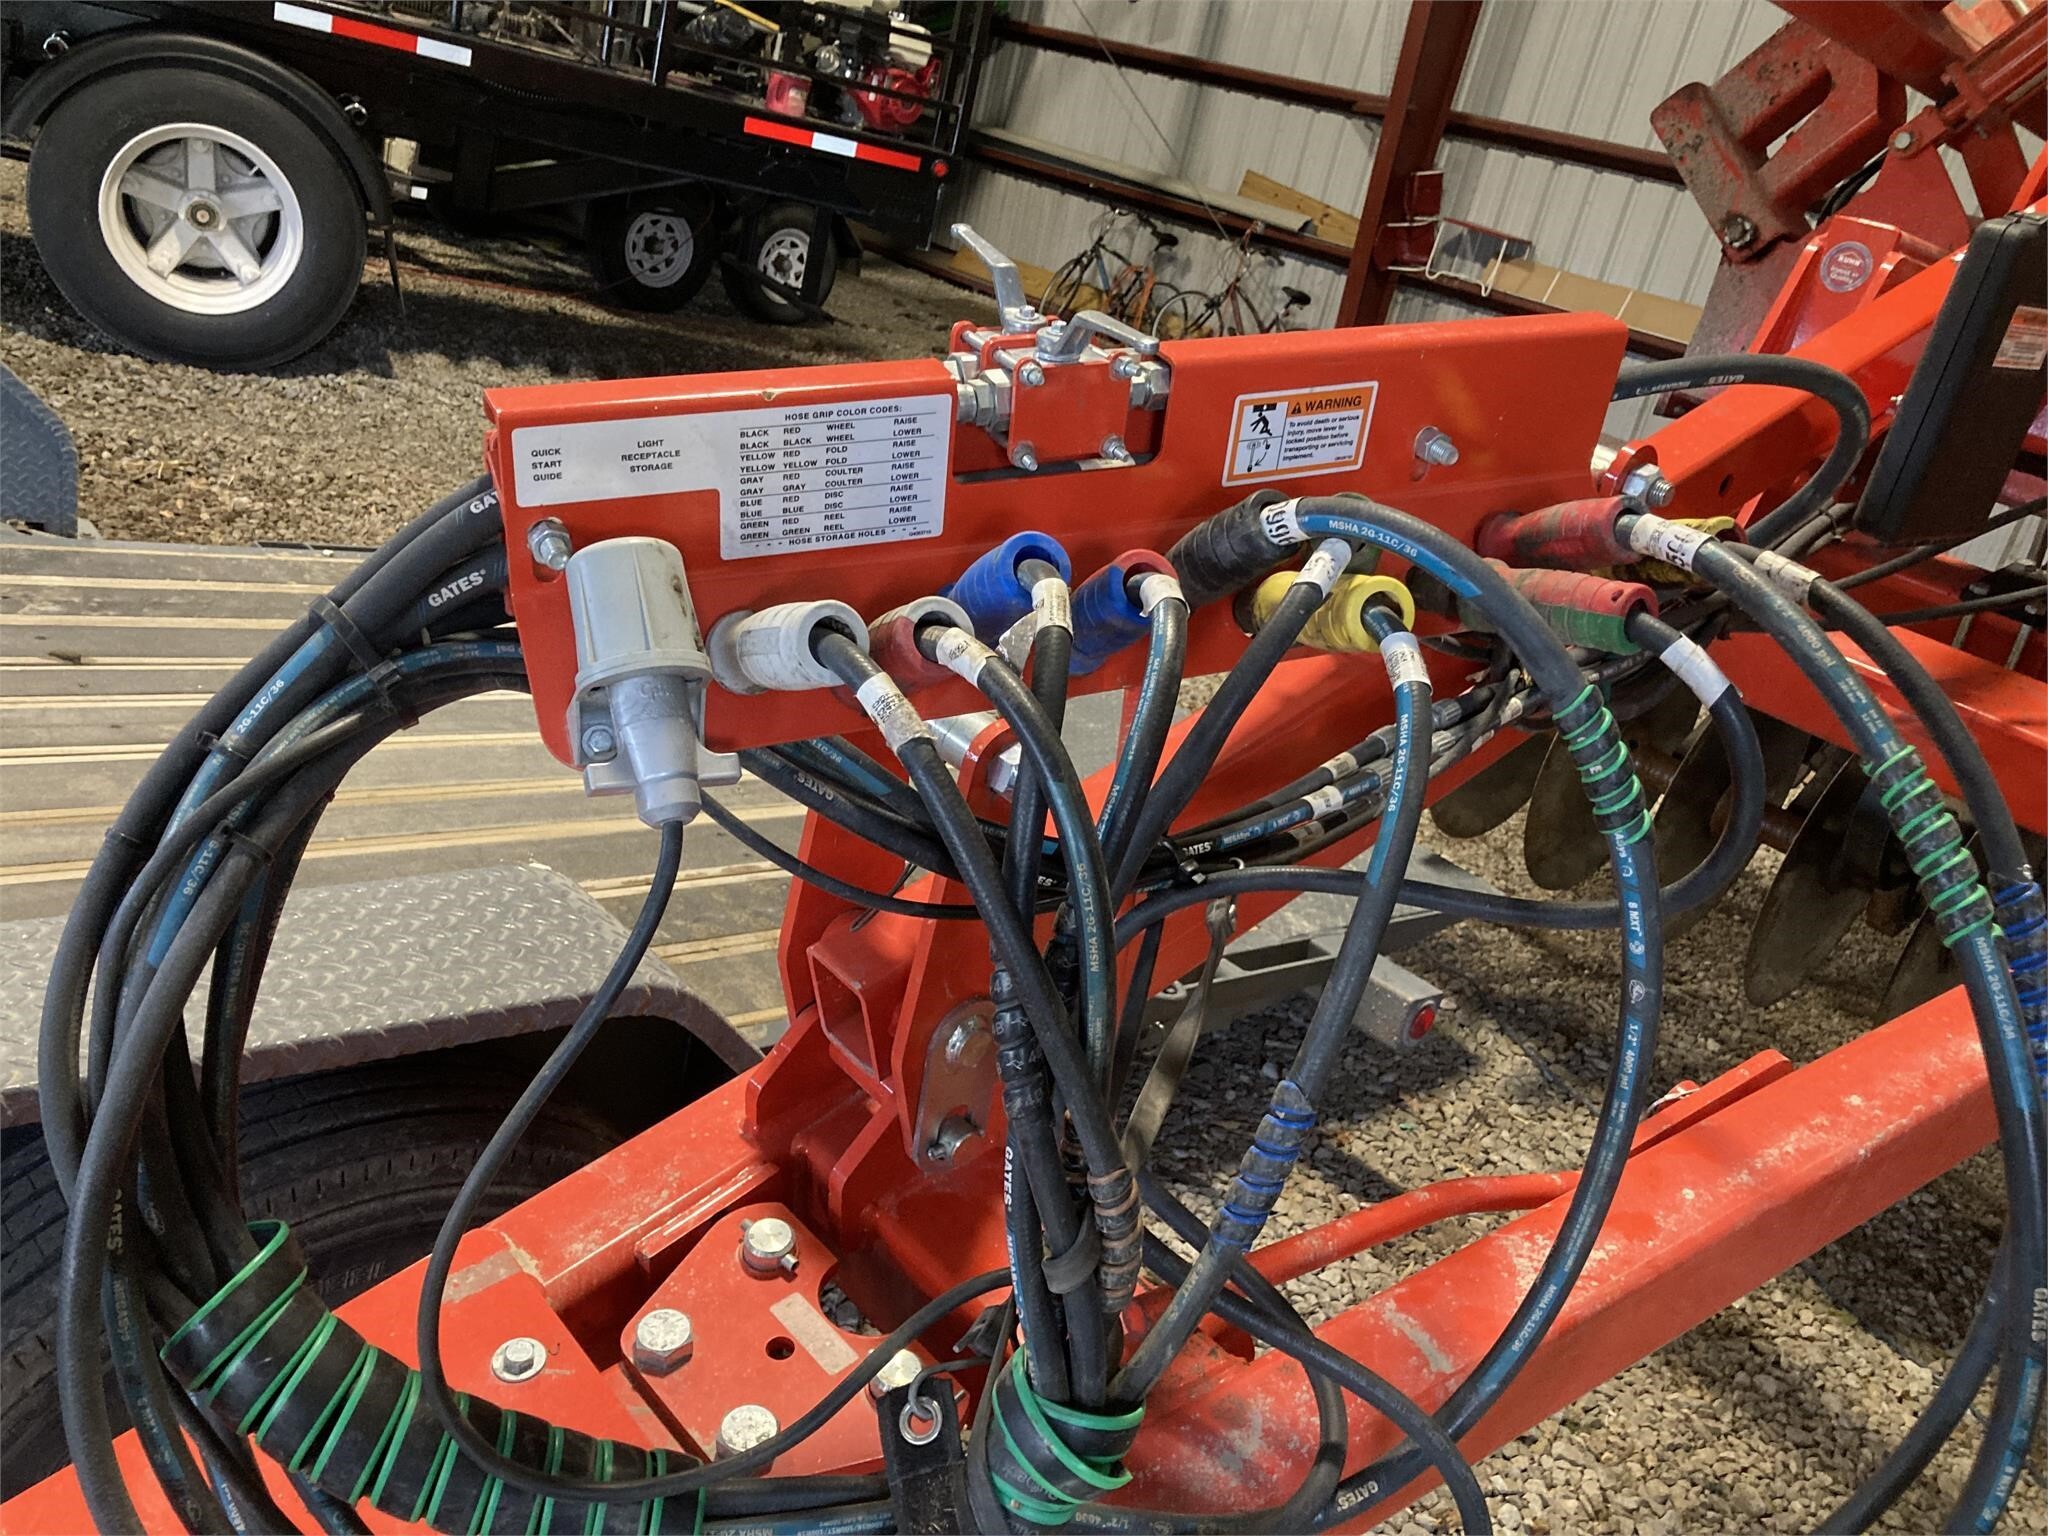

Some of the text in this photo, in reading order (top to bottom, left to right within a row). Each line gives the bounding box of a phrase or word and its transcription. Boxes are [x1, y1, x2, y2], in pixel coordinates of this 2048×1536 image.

[785, 405, 903, 421] HOSE GRIP COLOR CODES:
[1305, 395, 1362, 412] WARNING
[740, 417, 918, 439] BLACK RED WHEEL RAISE
[1296, 419, 1313, 427] avoid
[637, 439, 665, 449] LIGHT
[740, 427, 922, 450] BLACK BLACK WHEEL LOWER
[1284, 444, 1319, 453] transporting
[1327, 440, 1354, 448] servicing
[1285, 437, 1305, 445] locked
[1305, 435, 1329, 443] position
[531, 448, 562, 458] QUICK
[621, 450, 681, 462] RECEPTACLE
[740, 439, 917, 462] YELLOW RED FOLD RAISE
[740, 450, 921, 473] YELLOW YELLOW FOLD LOWER
[531, 460, 563, 470] START
[629, 462, 674, 473] STORAGE
[740, 462, 915, 485] GRAY RED COULTER RAISE
[533, 472, 563, 482] GUIDE
[740, 473, 920, 496] GRAY GRAY COULTER LOWER
[740, 484, 914, 507] BLUE RED DISC RAISE
[740, 494, 918, 519] BLUE BLUE DISC LOWER
[740, 506, 913, 530] GREEN RED REEL RAISE
[740, 516, 917, 541] GREEN GREEN REEL LOWER
[1329, 519, 1359, 534] MSHA
[788, 529, 886, 546] HOSE STORAGE HOLES
[428, 571, 484, 608] GATES
[1399, 713, 1409, 748] MSHA
[1089, 936, 1101, 973] MSHA
[1002, 1146, 1014, 1205] GATES
[1538, 1283, 1557, 1310] MSHA
[1336, 1480, 1379, 1512] GATES
